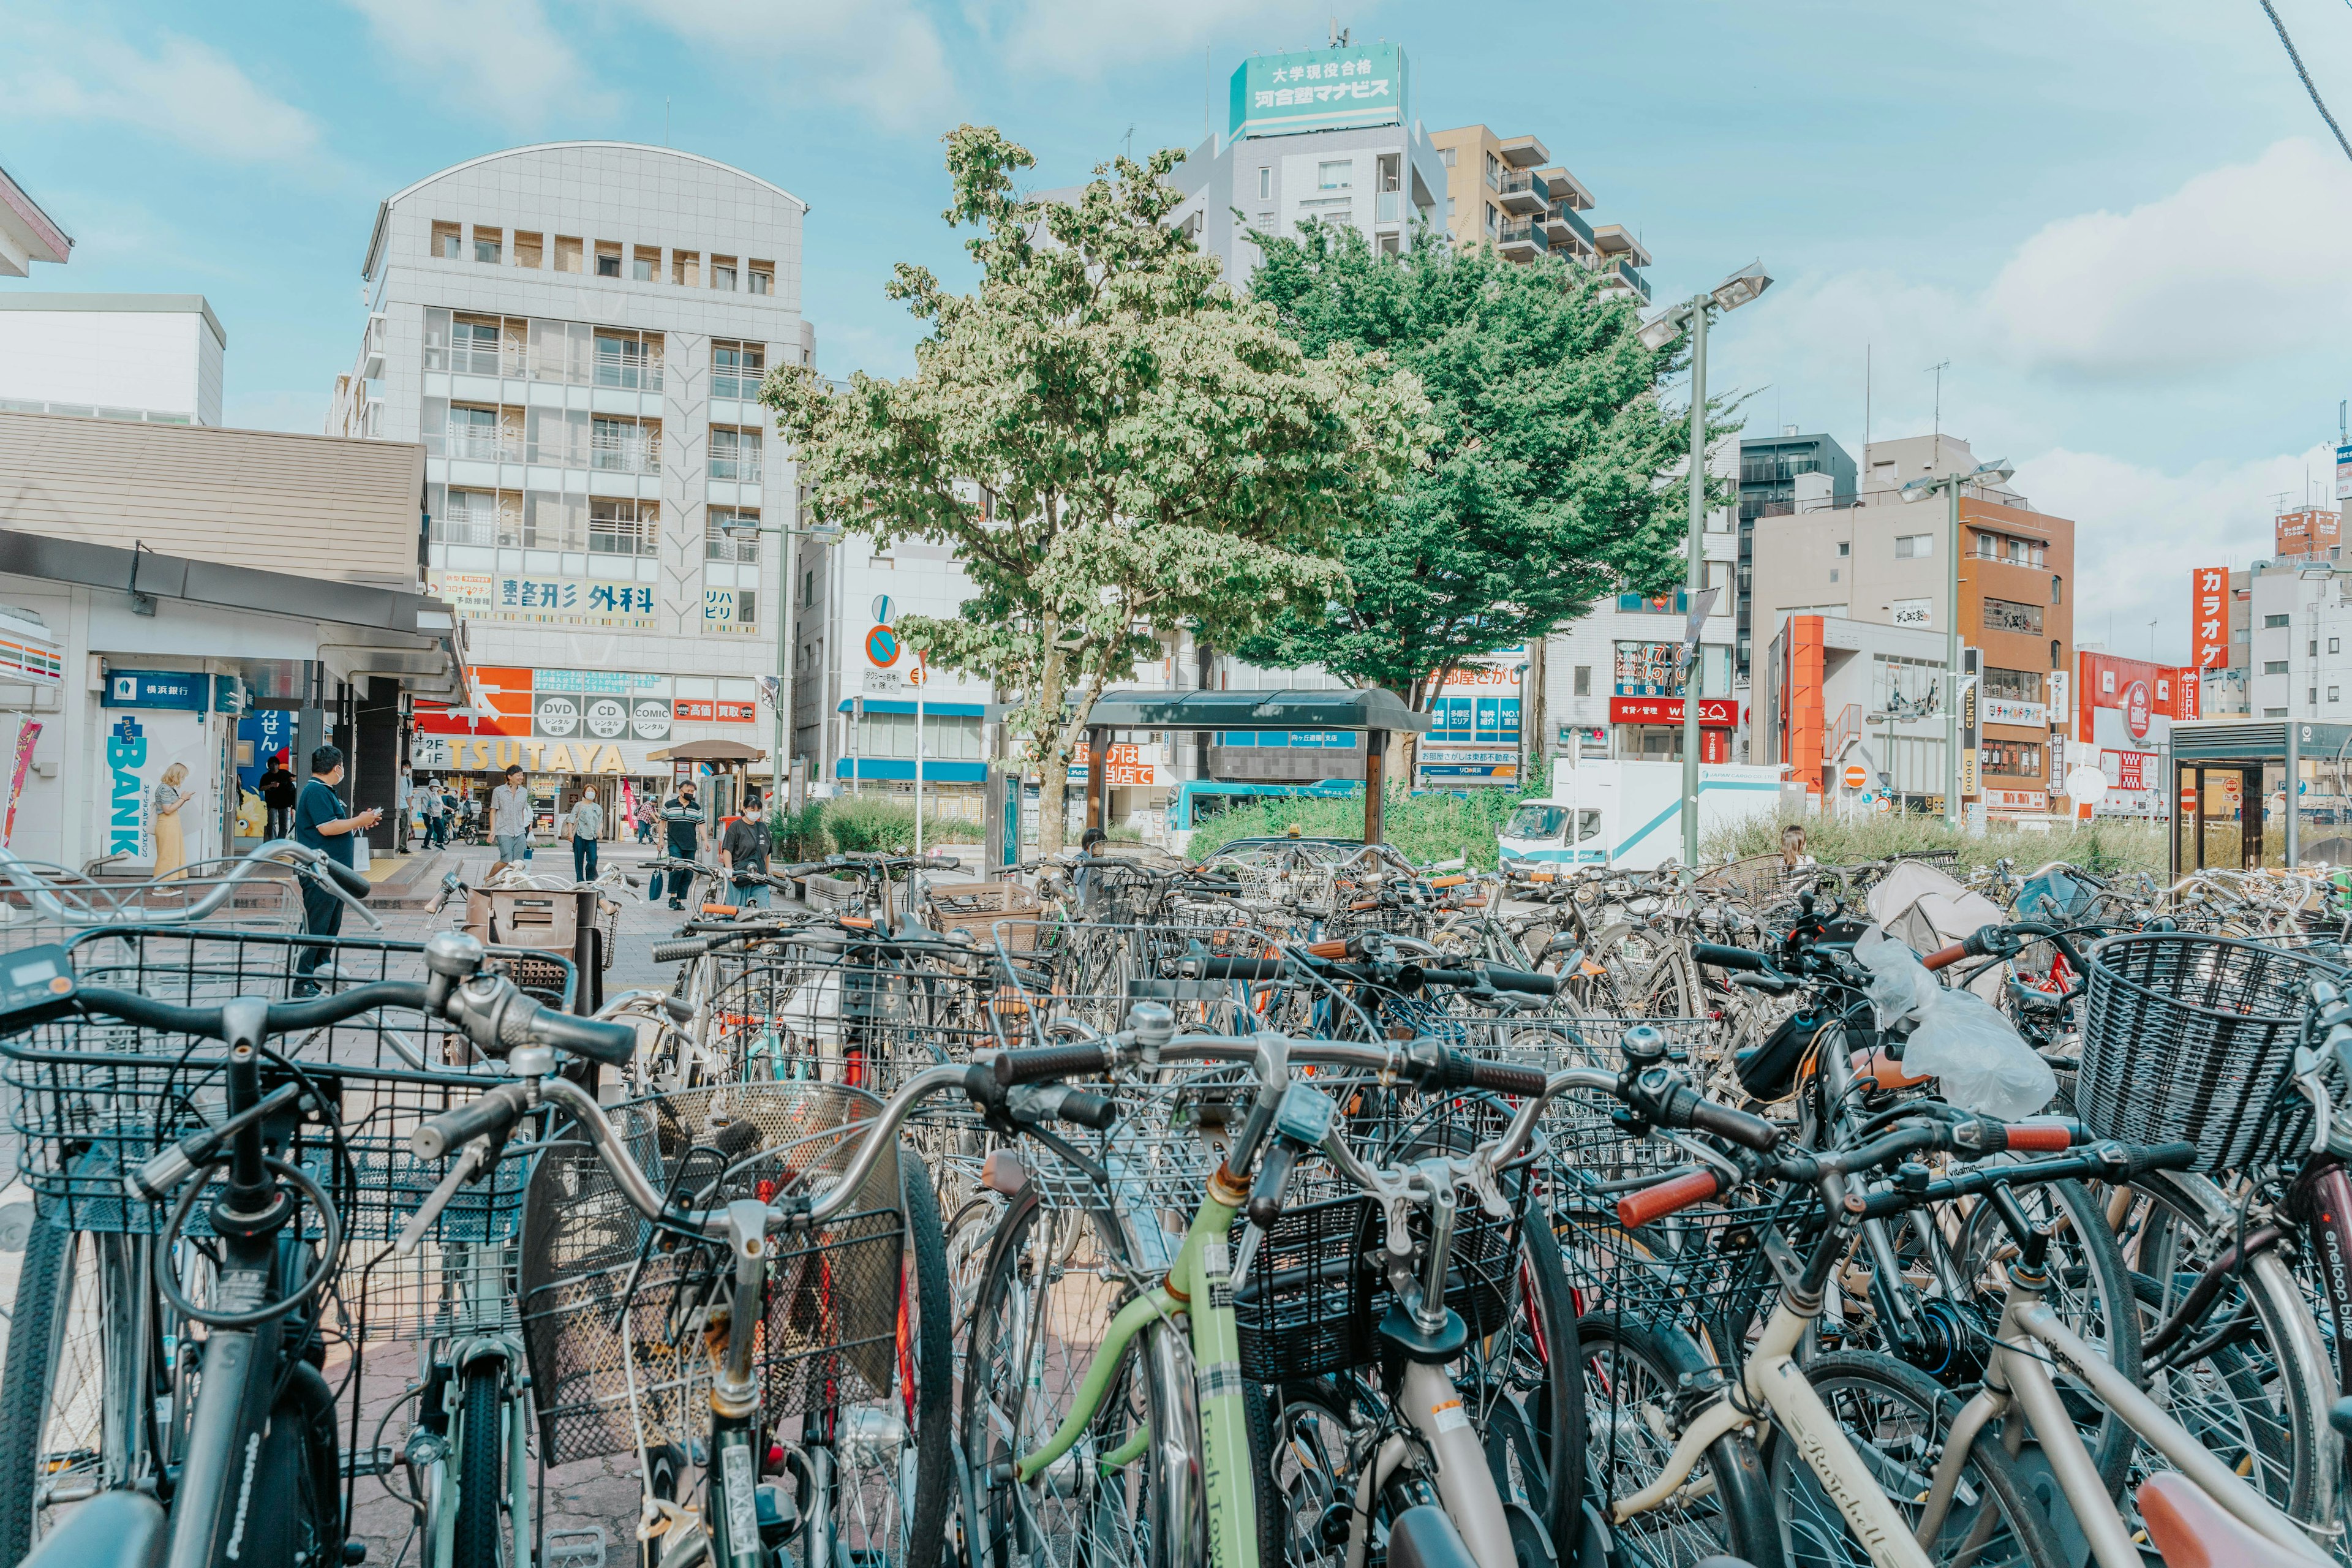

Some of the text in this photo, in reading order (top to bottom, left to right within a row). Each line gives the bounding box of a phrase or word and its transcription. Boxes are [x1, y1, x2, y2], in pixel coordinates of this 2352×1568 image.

[1272, 59, 1372, 83] 大学現役合格
[1255, 79, 1390, 108] 河合塾マナビス
[2278, 512, 2312, 529] トーア
[2316, 512, 2340, 526] トーア
[445, 586, 491, 594] コロナワクチン
[502, 579, 654, 614] 整形外科
[706, 590, 733, 604] リハ
[456, 597, 490, 605] 予防接種
[705, 605, 732, 620] ビリ
[2201, 571, 2221, 664] カラオケ
[865, 671, 900, 682] タクシーの客待ち
[1427, 667, 1520, 686] お部屋さがし
[146, 685, 188, 696] 横浜銀行
[872, 681, 894, 690] を除く
[544, 704, 572, 714] DVD
[598, 706, 616, 716] CD
[635, 709, 668, 718] COMIC
[690, 704, 712, 717] 高価
[718, 705, 739, 718] 買取
[1966, 685, 1975, 729] CENTUR
[1480, 717, 1495, 726] 紹介
[1504, 717, 1519, 726] 宣言
[2131, 706, 2147, 724] GAME
[122, 719, 134, 742] PLUS
[426, 739, 443, 750] 2F
[428, 753, 443, 764] 1F
[1422, 753, 1517, 762] お部屋さがしは東都不動産へ
[1981, 748, 2040, 767] 村山歯科医院
[2052, 735, 2063, 789] 村山歯科医院
[107, 736, 148, 856] BANK
[1686, 962, 1698, 993] LOUIS
[1949, 1165, 1976, 1176] vitamin
[2325, 1231, 2352, 1340] eneloop bike
[1200, 1410, 1220, 1486] Fresh
[1804, 1433, 1886, 1547] Raychell
